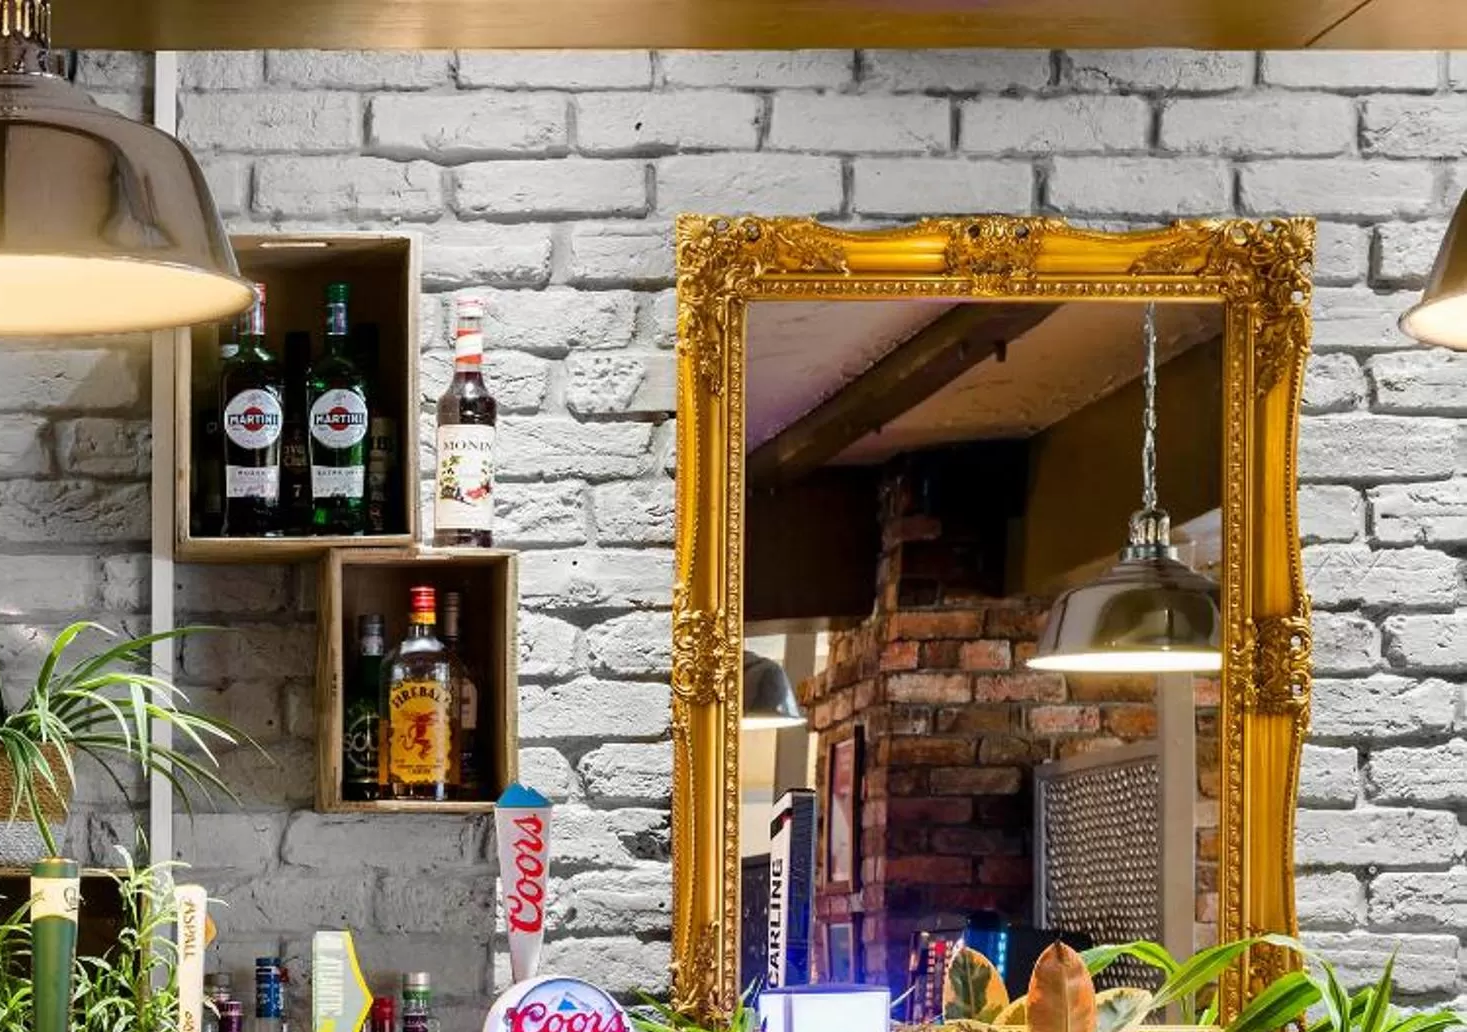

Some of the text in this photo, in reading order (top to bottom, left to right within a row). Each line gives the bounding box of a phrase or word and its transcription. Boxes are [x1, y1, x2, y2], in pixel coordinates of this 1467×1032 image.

[228, 413, 279, 425] MARTINI
[314, 412, 365, 425] MARTINI
[443, 440, 493, 451] MONIN
[507, 814, 544, 933] Coors
[183, 899, 198, 958] ASPALL
[768, 857, 784, 988] CARLING
